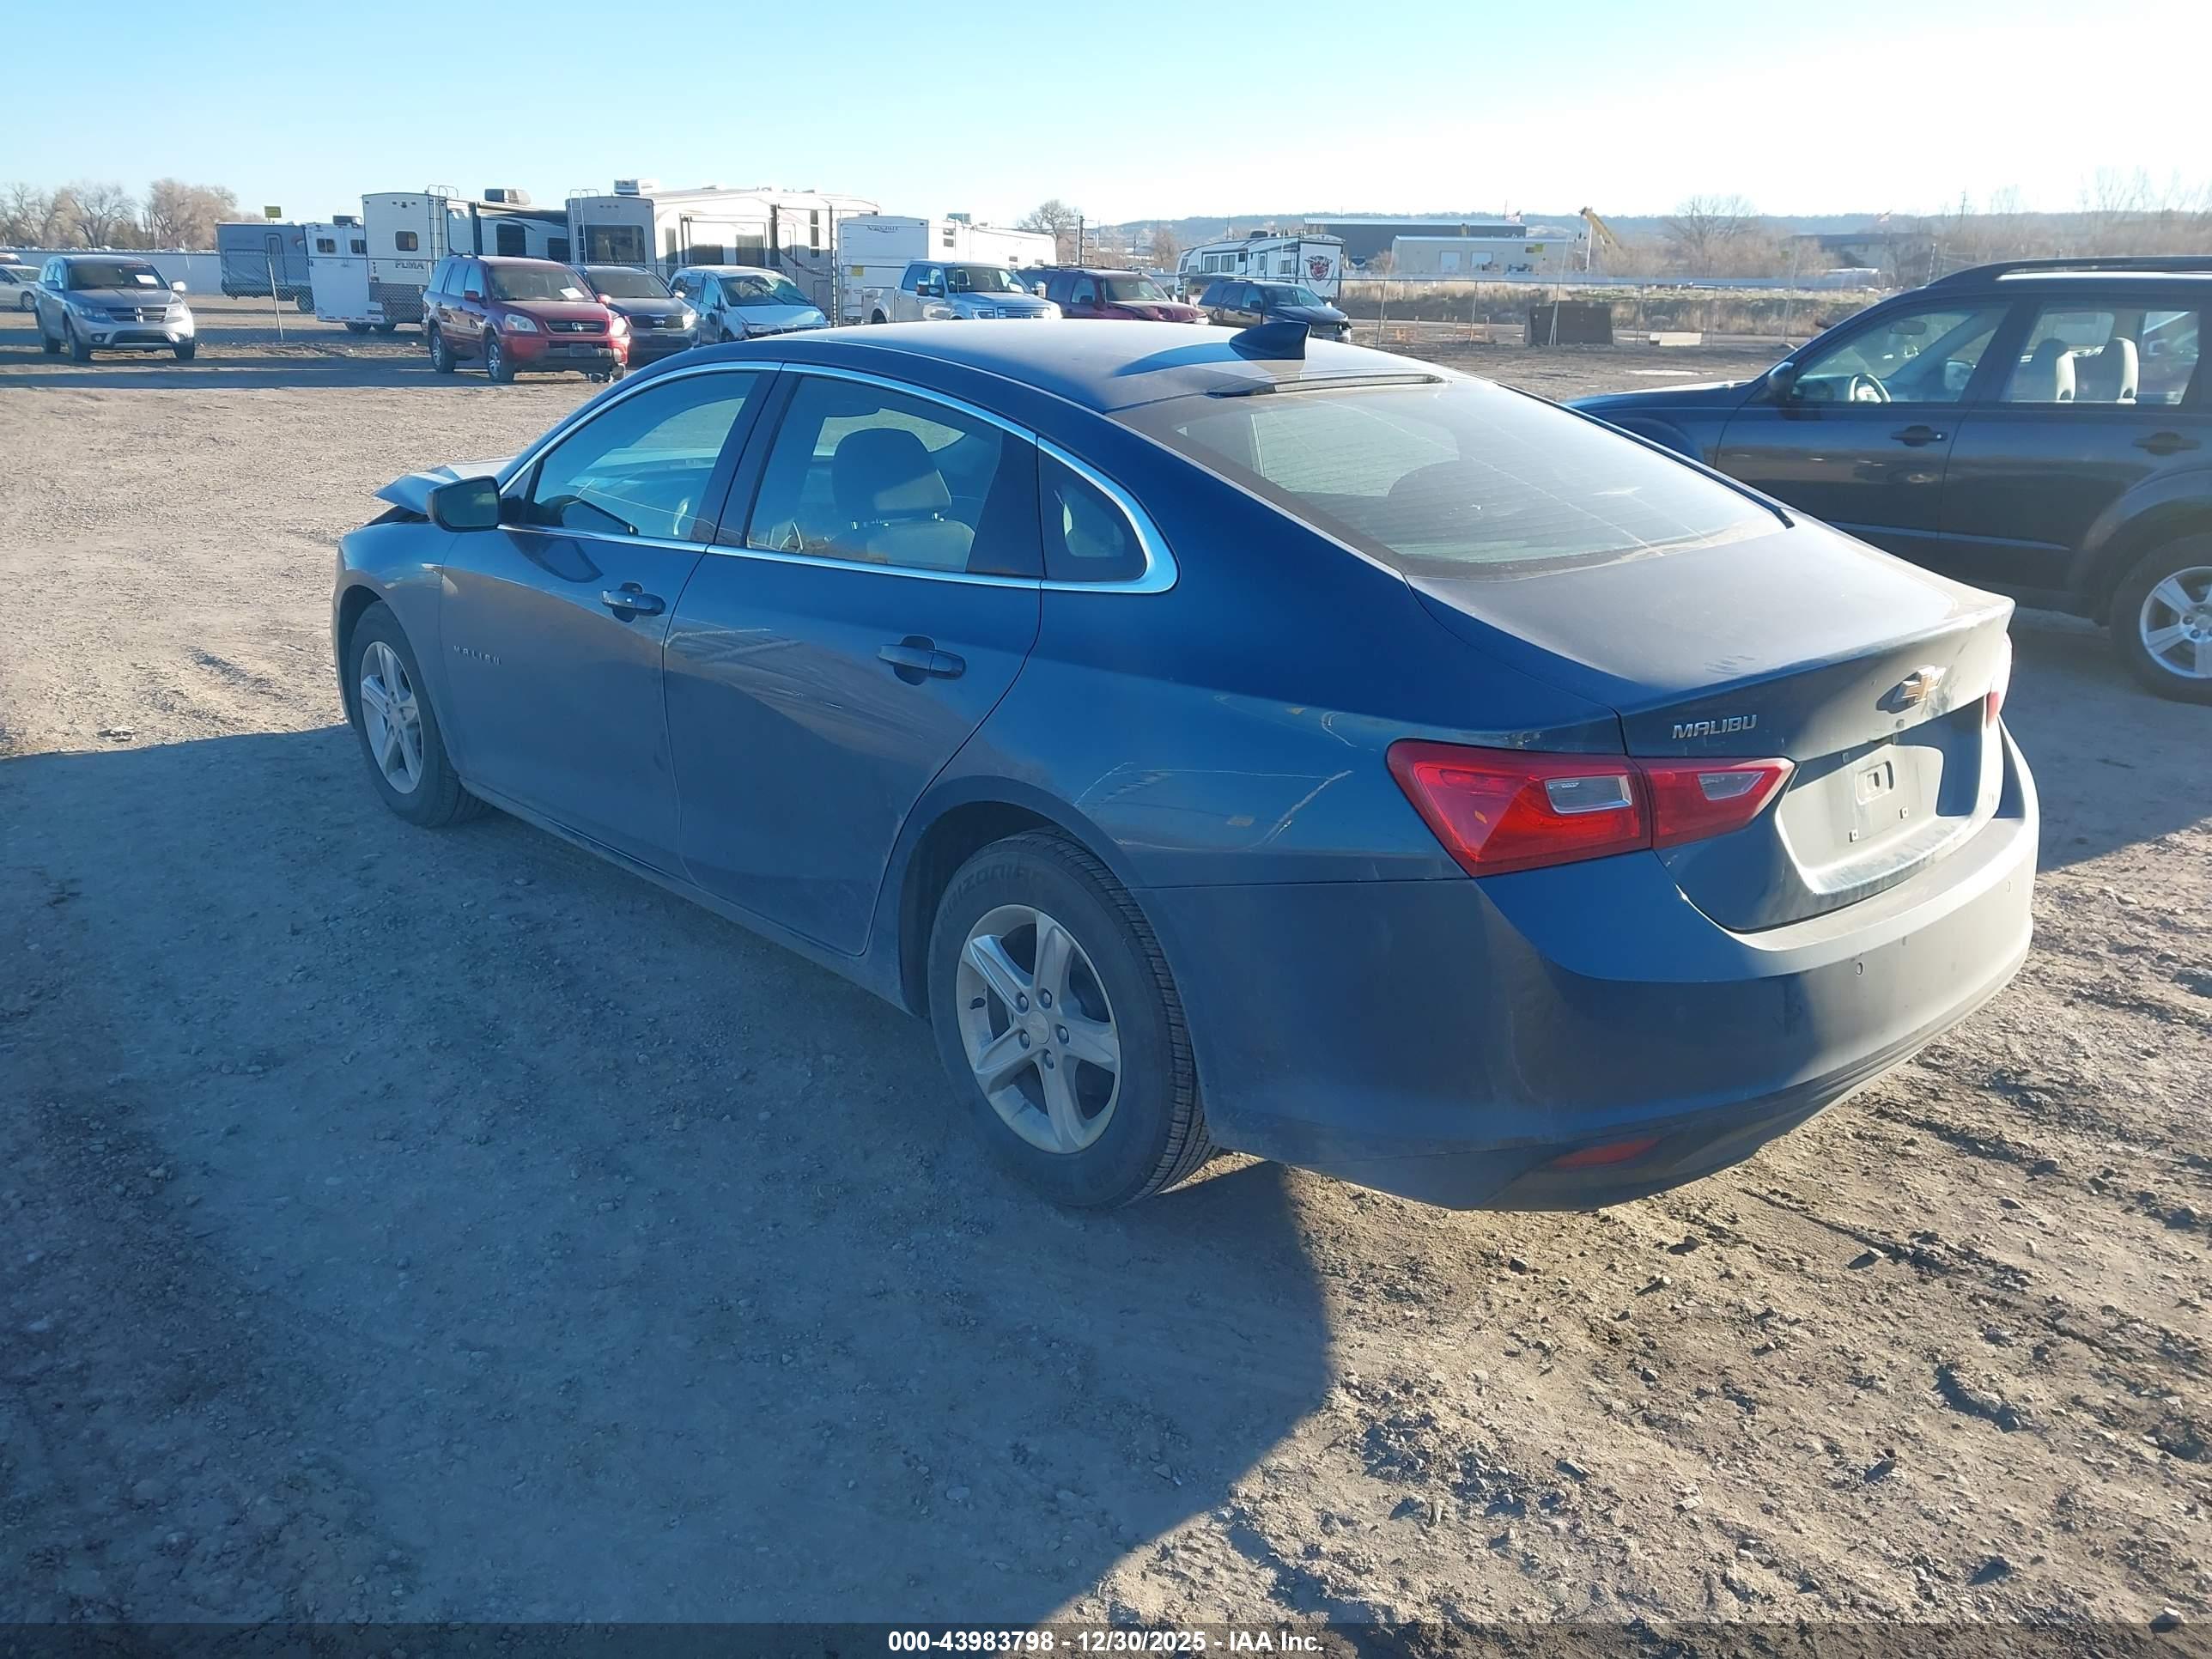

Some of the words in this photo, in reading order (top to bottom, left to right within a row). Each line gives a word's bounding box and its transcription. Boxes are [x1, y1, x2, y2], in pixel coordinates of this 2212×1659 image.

[394, 260, 425, 270] PUMA
[453, 645, 501, 666] MALIBU
[1671, 714, 1759, 739] MALIBU
